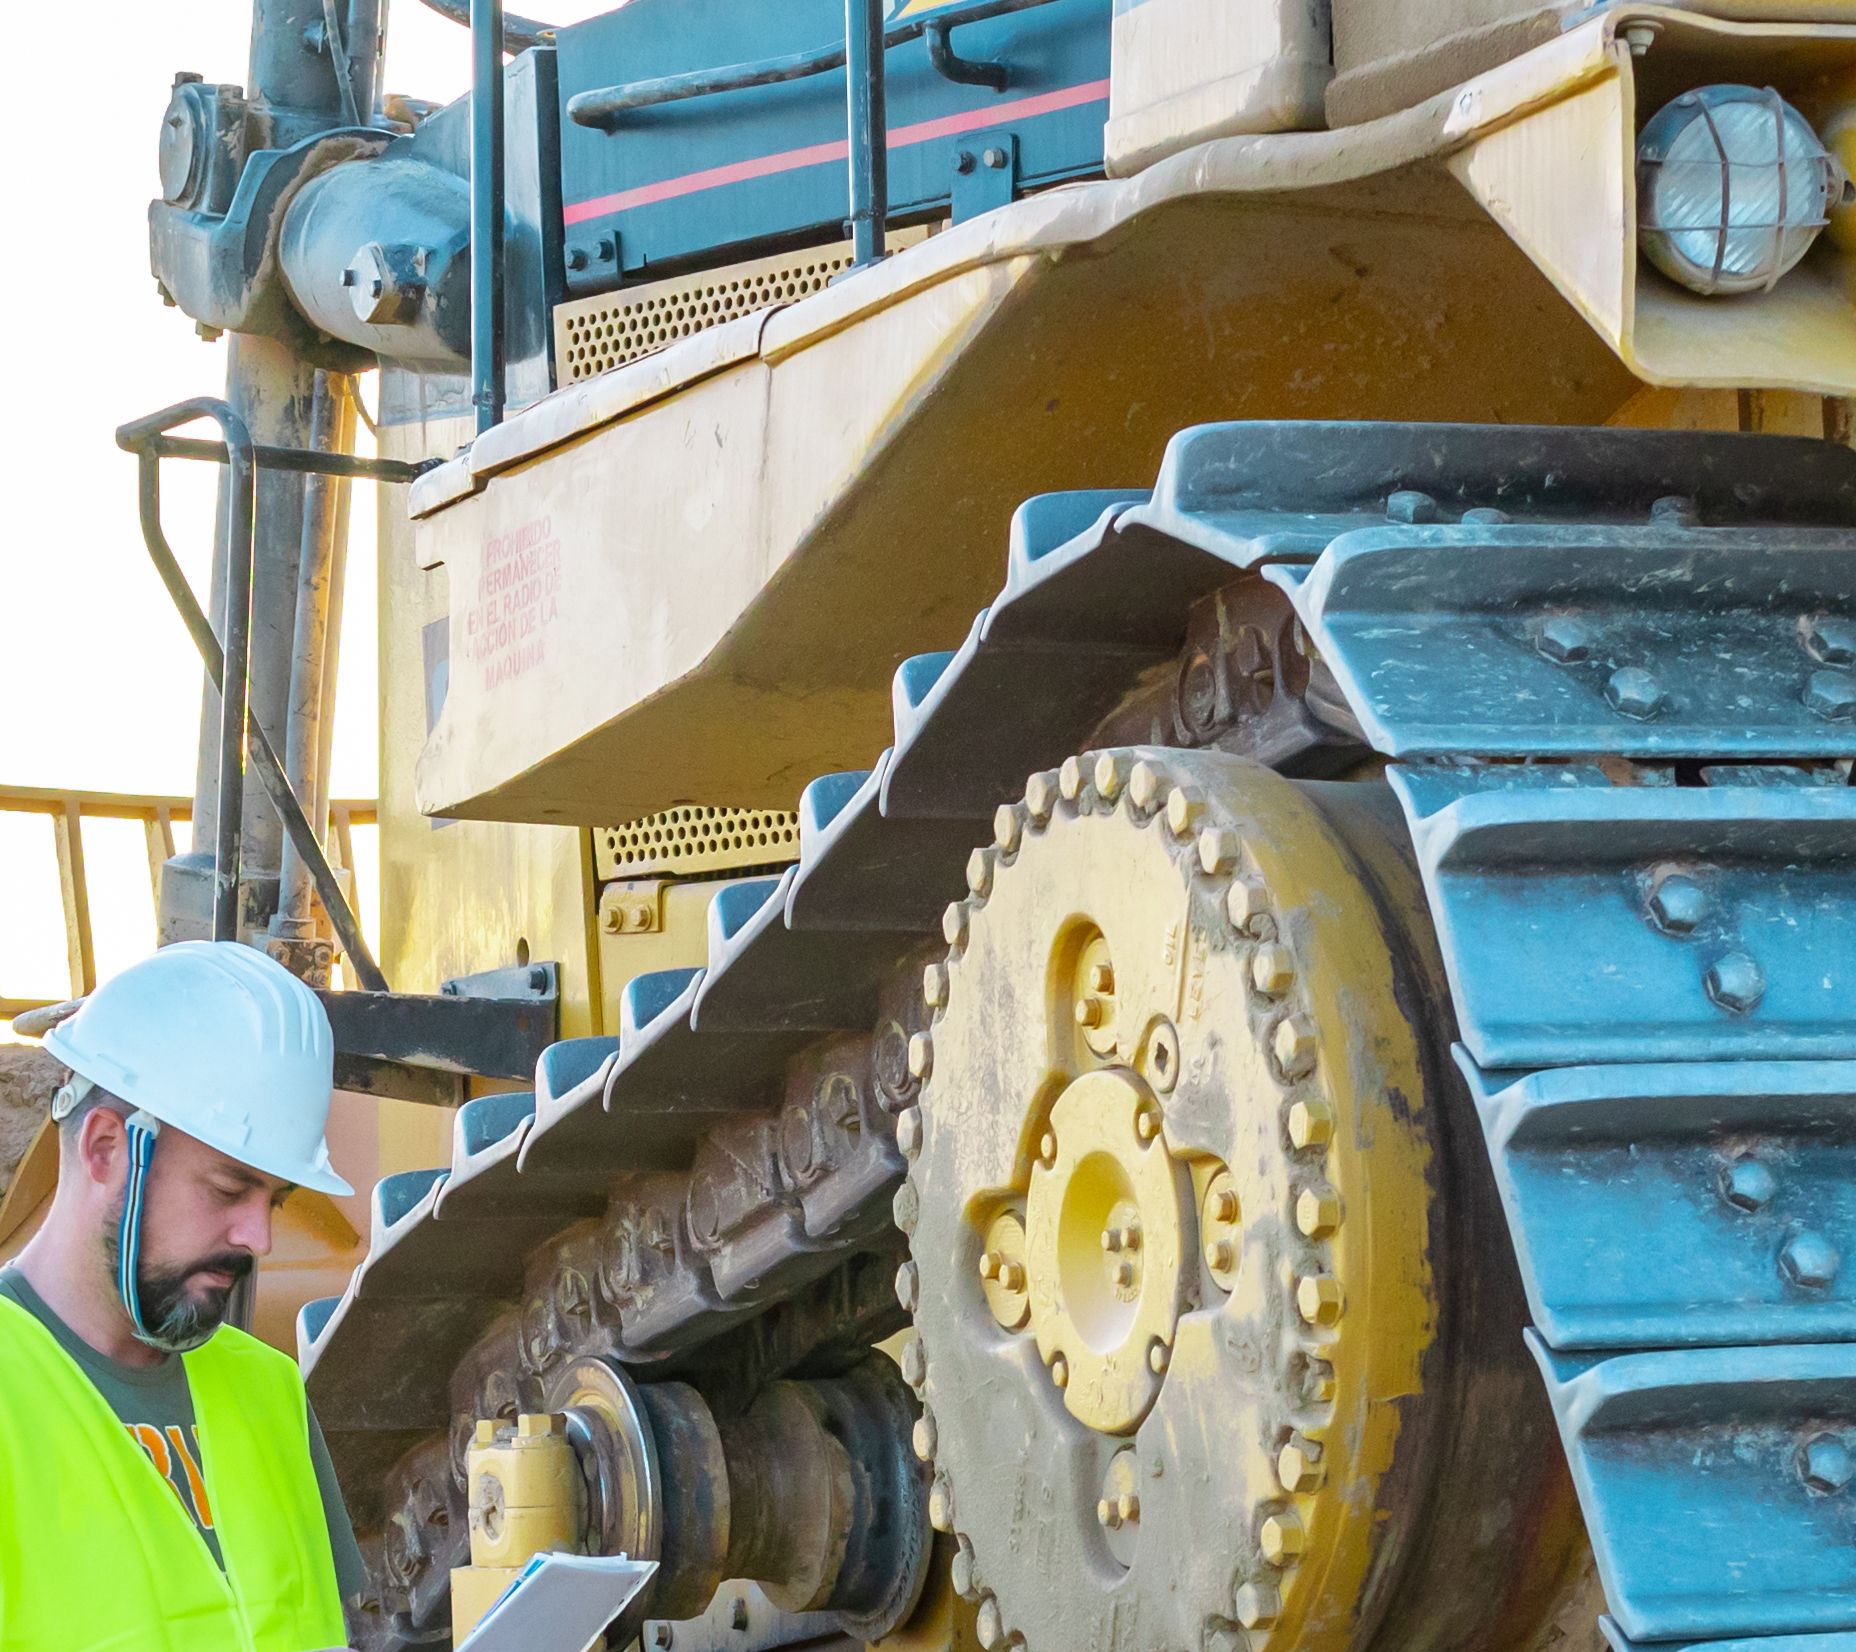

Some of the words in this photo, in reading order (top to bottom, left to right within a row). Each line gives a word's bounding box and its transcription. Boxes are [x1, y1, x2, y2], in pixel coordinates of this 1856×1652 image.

[478, 539, 561, 601] PERMANECER
[486, 515, 552, 567] PROHIBIDO
[468, 605, 484, 635] EN
[487, 600, 499, 626] EL
[503, 576, 541, 616] RADIO
[545, 568, 561, 596] DE
[473, 618, 516, 661] ACCION
[520, 606, 536, 639] DE
[540, 596, 558, 626] LA
[485, 637, 545, 691] MAQUINA
